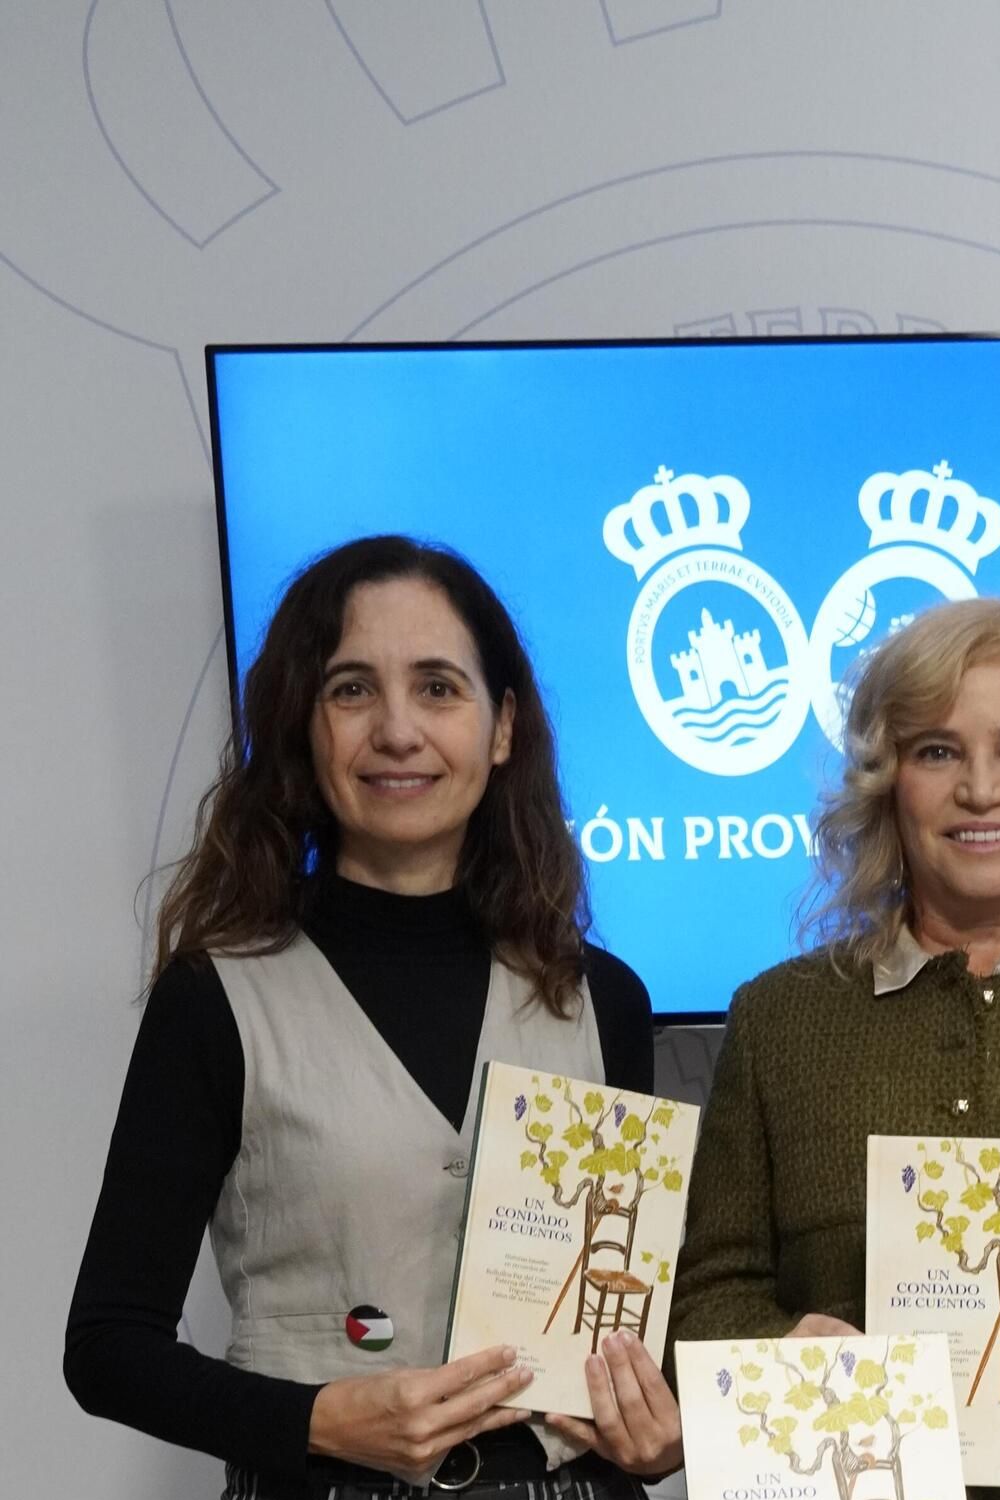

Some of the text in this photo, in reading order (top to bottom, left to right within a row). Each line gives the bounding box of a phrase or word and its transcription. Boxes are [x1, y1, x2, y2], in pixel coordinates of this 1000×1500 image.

[646, 575, 676, 609] MARIS
[677, 565, 691, 579] ET
[524, 1197, 545, 1210] UN
[496, 1206, 569, 1229] CONDADO
[489, 1218, 572, 1243] DE CUENTOS
[927, 1269, 950, 1281] UN
[897, 1282, 980, 1295] CONDADO
[890, 1296, 986, 1310] DE CUENTOS
[756, 1473, 781, 1485] UN
[723, 1486, 817, 1500] CONDADO
